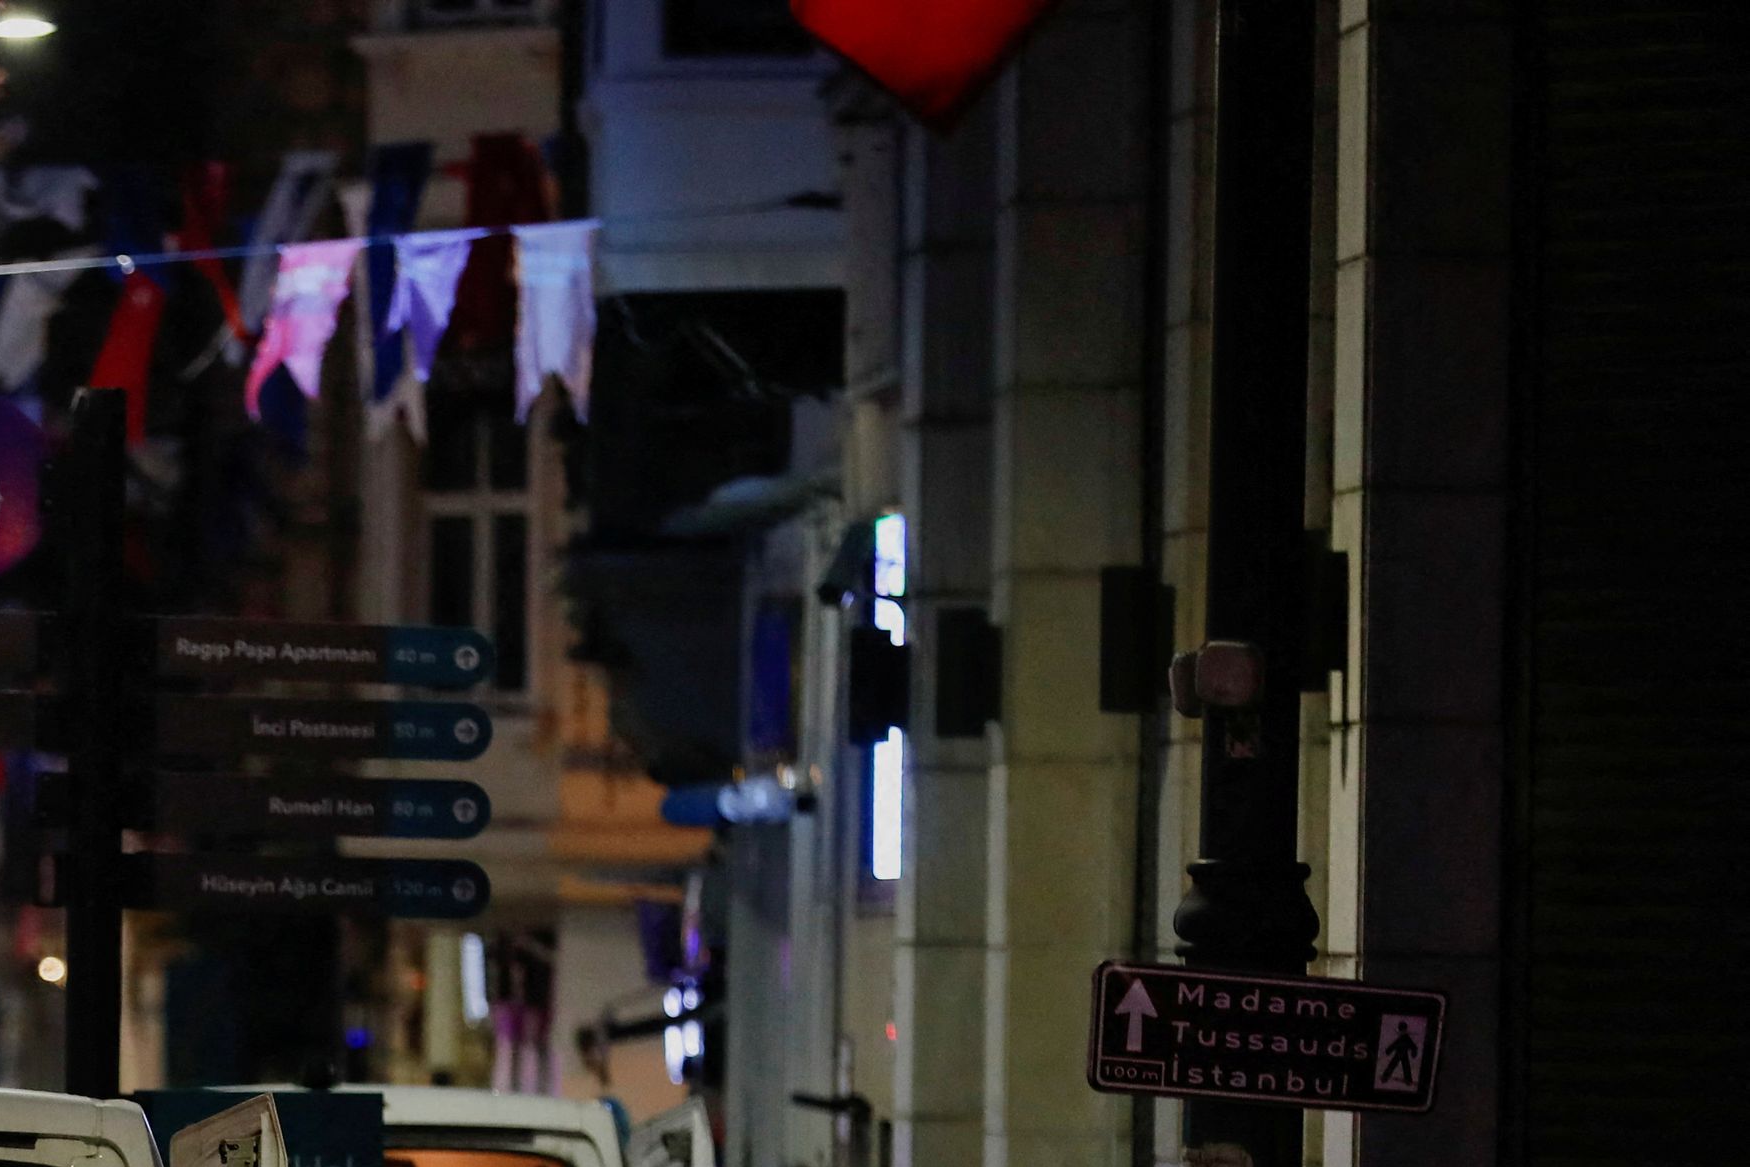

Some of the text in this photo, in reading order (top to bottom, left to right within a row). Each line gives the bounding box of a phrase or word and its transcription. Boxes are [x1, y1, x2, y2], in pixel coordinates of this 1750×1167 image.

[234, 639, 276, 663] Paşa
[418, 652, 437, 663] m
[418, 726, 437, 738] m
[268, 795, 333, 816] Rumeli
[337, 799, 375, 817] Han
[417, 803, 434, 816] m
[200, 871, 275, 897] Hüseyin
[279, 876, 317, 899] Ağa
[1176, 981, 1356, 1021] Madame
[1171, 1020, 1370, 1061] Tussauds
[1171, 1052, 1352, 1097] İstanbul
